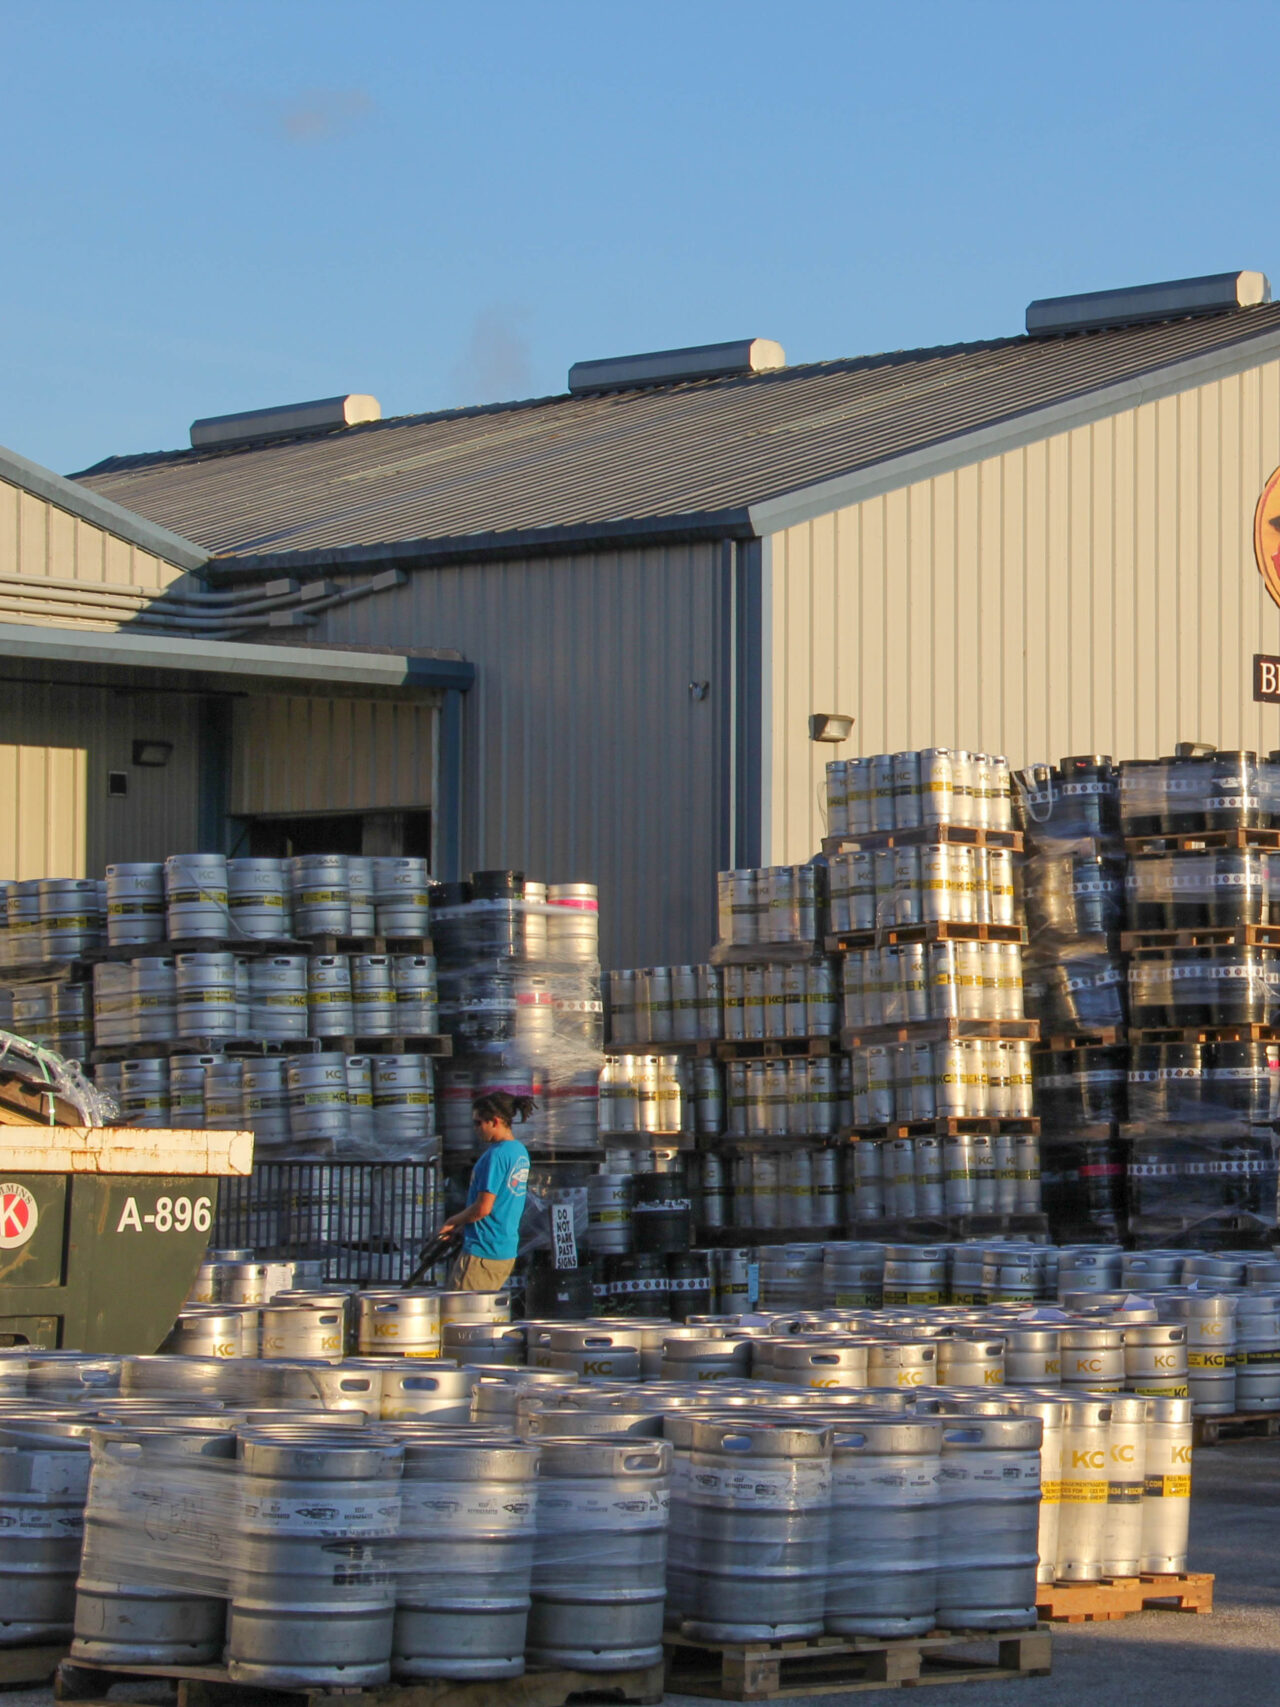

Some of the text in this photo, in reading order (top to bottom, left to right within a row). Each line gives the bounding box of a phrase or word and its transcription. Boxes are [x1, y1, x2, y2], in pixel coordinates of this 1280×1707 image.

[326, 1069, 342, 1079] KC
[379, 1071, 396, 1081] KC
[116, 1196, 212, 1233] A-896
[557, 1209, 568, 1220] DO
[556, 1221, 571, 1232] NOT
[556, 1232, 573, 1245] PARK
[557, 1244, 573, 1256] PAST
[557, 1256, 577, 1269] SIGNS
[865, 1295, 881, 1304] KC
[374, 1324, 398, 1337] KC
[1200, 1323, 1221, 1336] KC
[264, 1337, 284, 1349] KC
[321, 1336, 340, 1349] KC
[213, 1343, 235, 1356] KC
[1046, 1360, 1060, 1372] KC
[1077, 1360, 1102, 1371] KC
[1154, 1355, 1176, 1367] KC
[1204, 1355, 1223, 1366] KC
[584, 1361, 613, 1375] KC
[898, 1371, 923, 1384] KC
[984, 1370, 1003, 1383] KC
[1072, 1451, 1105, 1469] KC
[1110, 1445, 1135, 1462] KC
